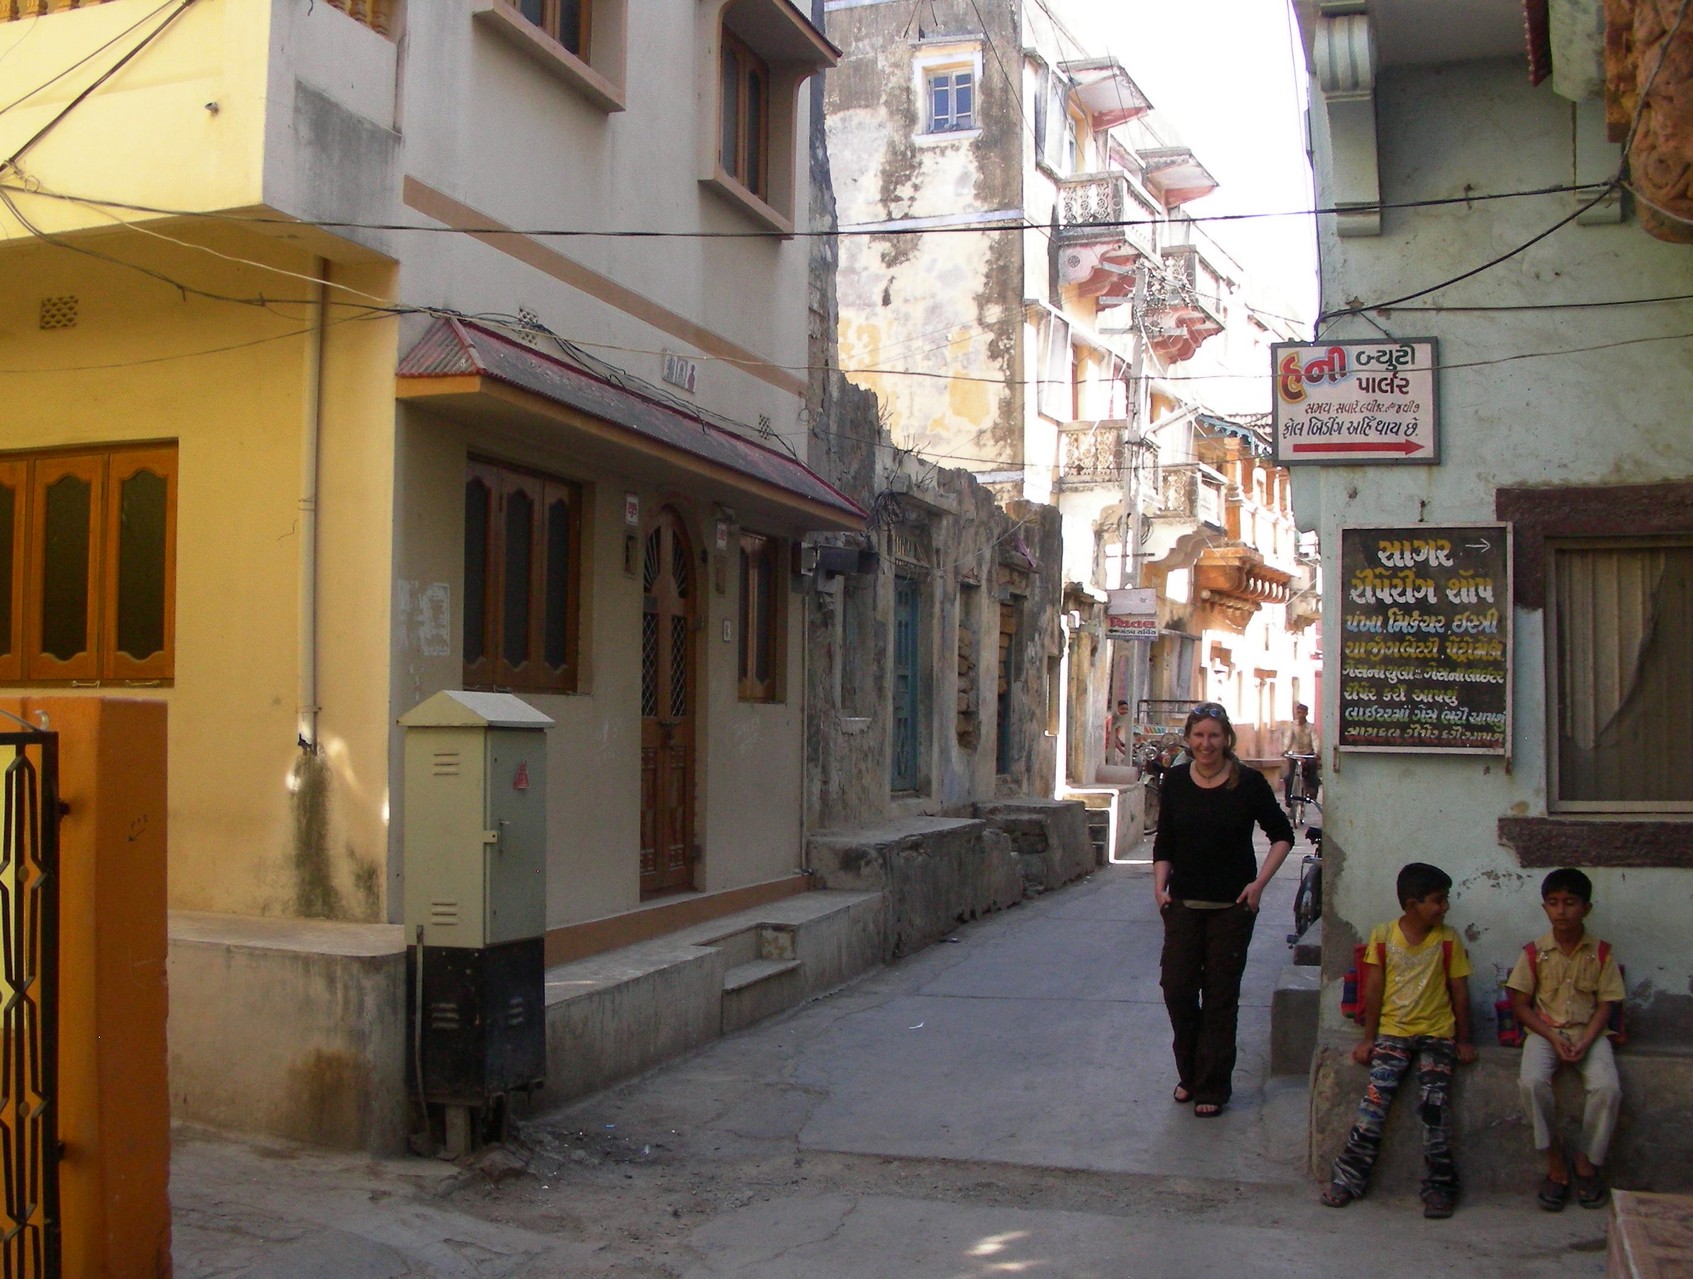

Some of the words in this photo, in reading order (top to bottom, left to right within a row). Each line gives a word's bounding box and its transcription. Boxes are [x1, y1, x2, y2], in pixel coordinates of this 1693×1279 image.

[1278, 346, 1348, 404] હની
[1356, 372, 1410, 394] પાર્લર
[1376, 420, 1402, 436] થાય
[1378, 539, 1454, 567] સાગર
